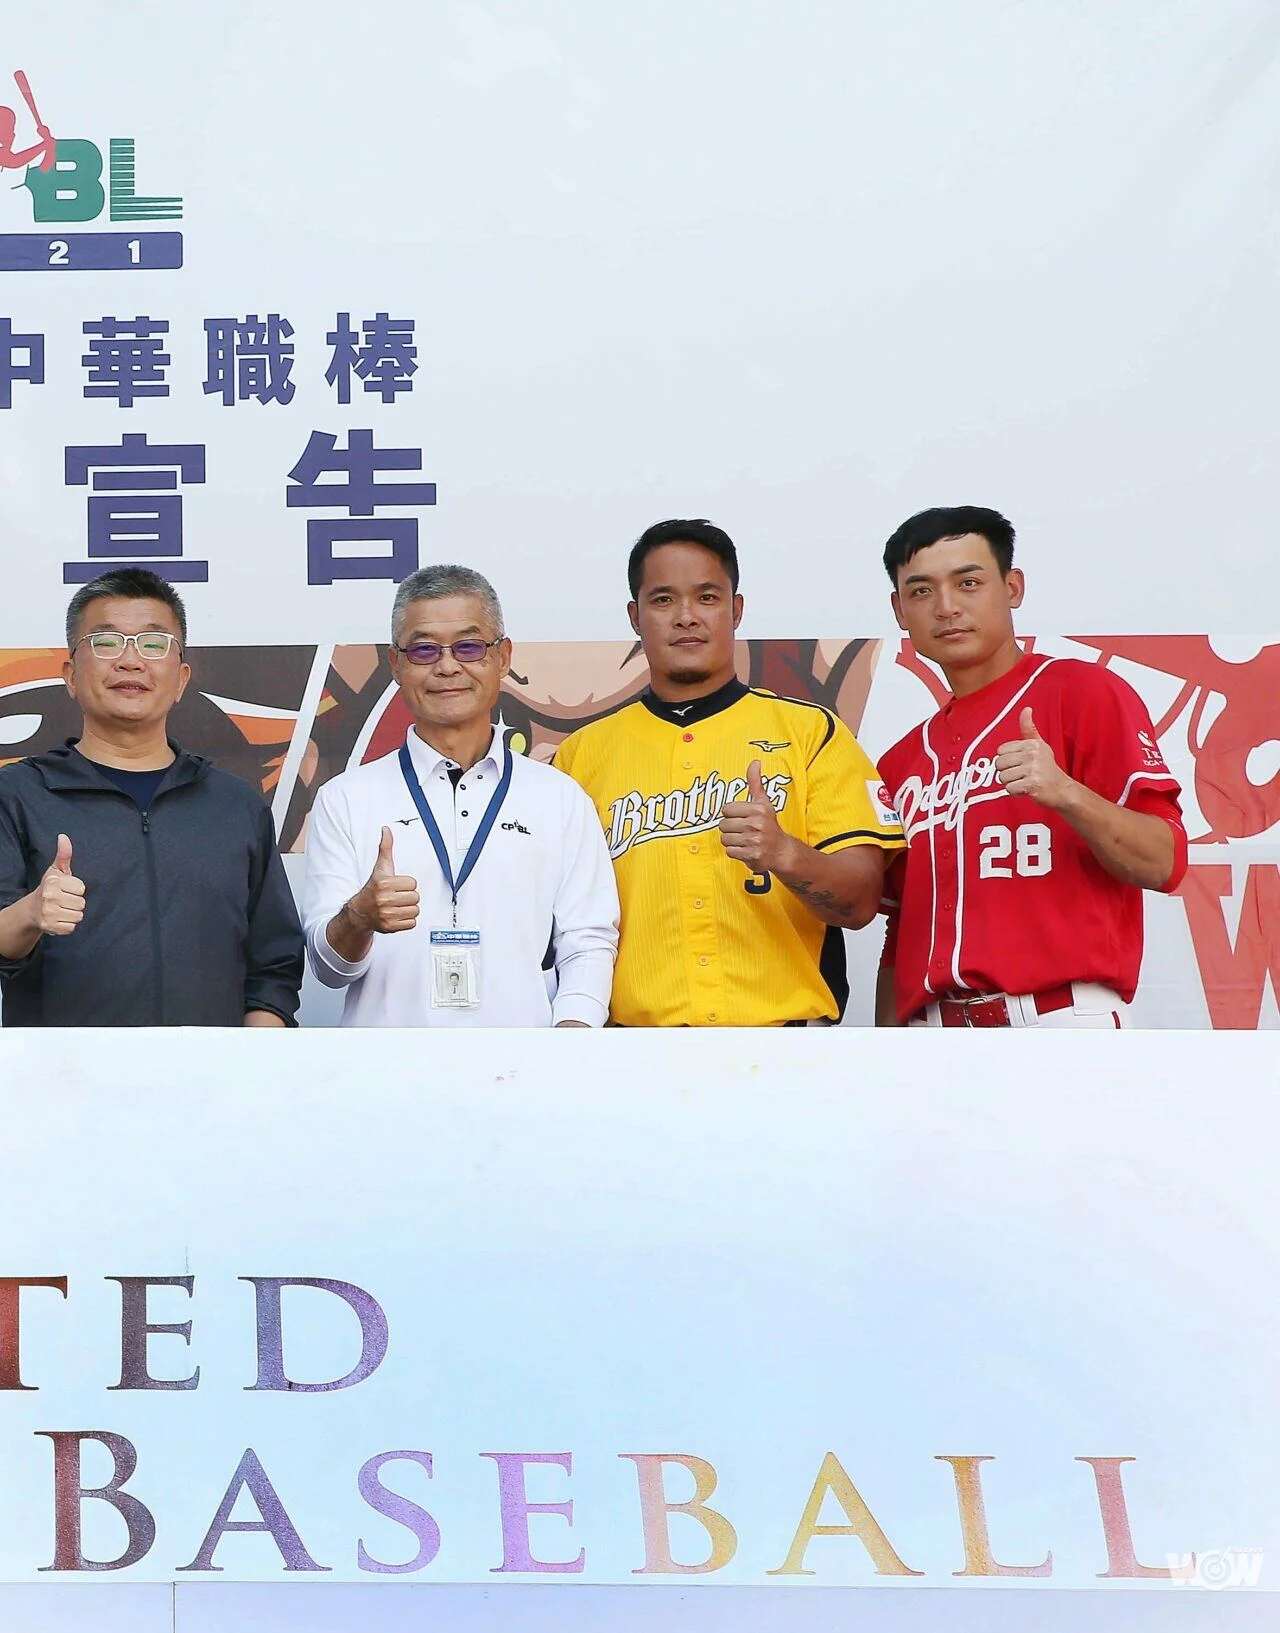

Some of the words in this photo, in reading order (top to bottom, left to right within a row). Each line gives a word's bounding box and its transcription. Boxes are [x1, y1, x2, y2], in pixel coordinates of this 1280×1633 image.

[893, 755, 1004, 848] Dragon
[979, 823, 1053, 879] 28
[33, 1430, 1197, 1580] BASEBALL
